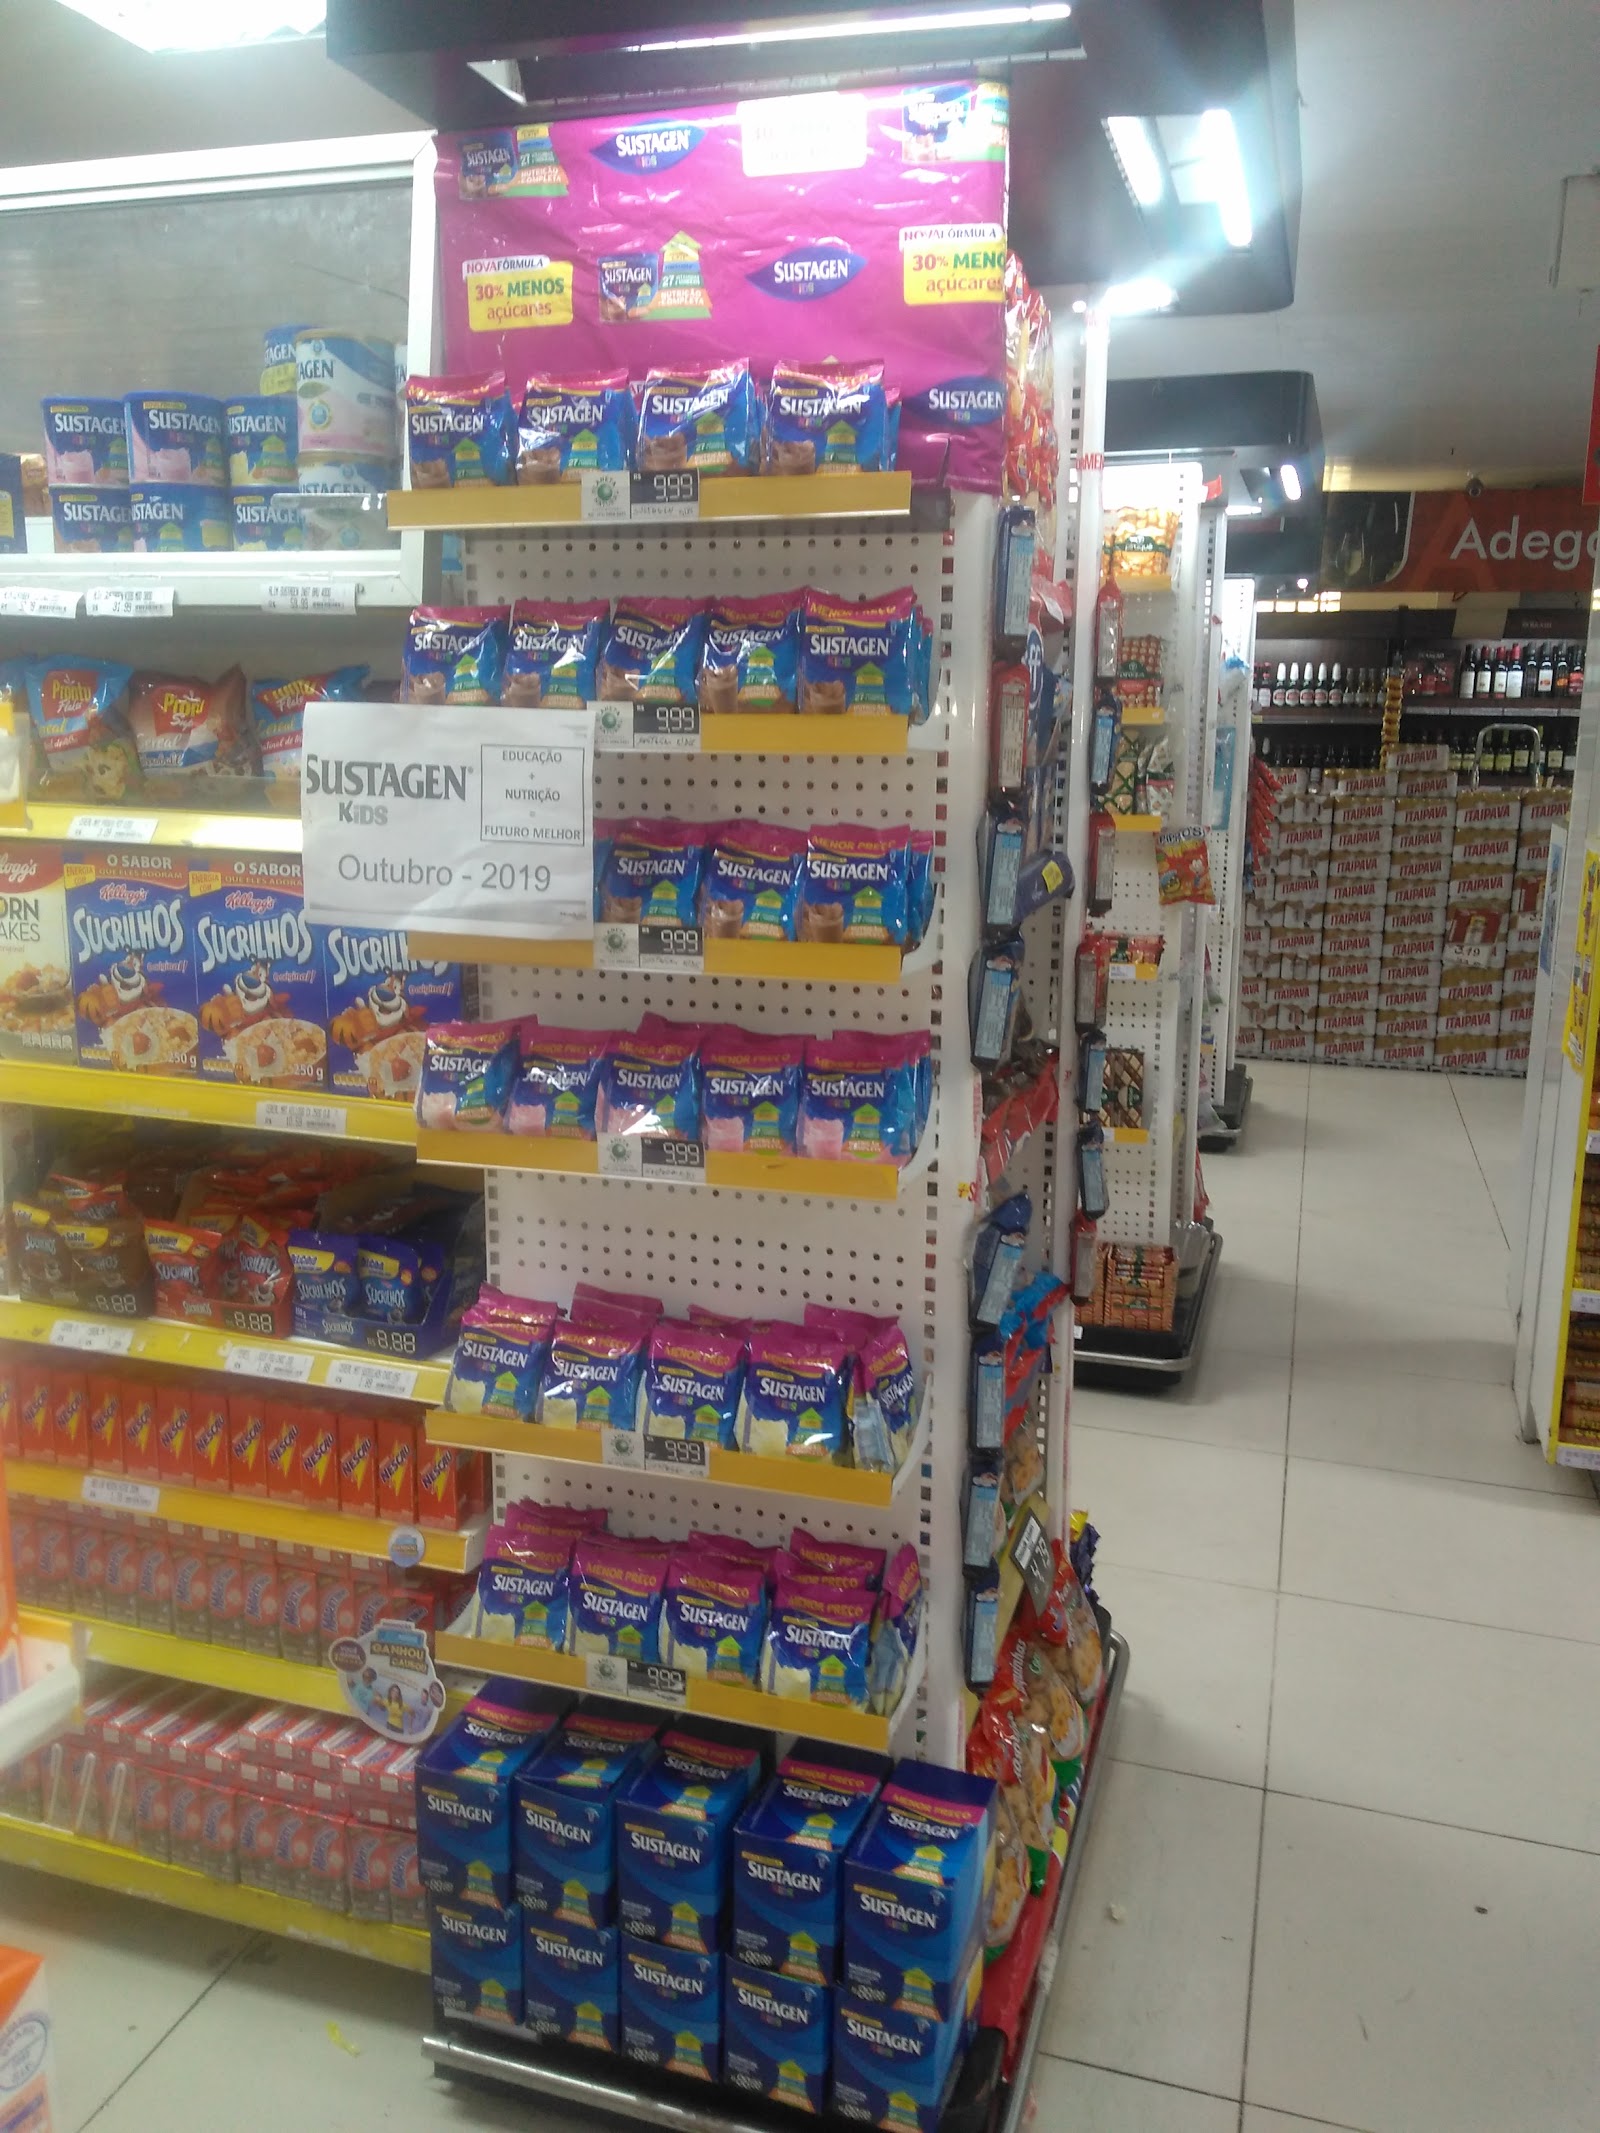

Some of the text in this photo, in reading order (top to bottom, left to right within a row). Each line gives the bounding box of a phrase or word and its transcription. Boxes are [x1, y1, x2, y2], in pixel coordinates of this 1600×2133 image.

[616, 129, 691, 157] SUSTAGEN
[774, 259, 850, 283] SUSTAGEN
[912, 254, 949, 271] 30%
[475, 277, 565, 301] 30% MENOS
[604, 267, 651, 285] SUSTAGEN
[929, 388, 1005, 410] SUSTAGEN
[411, 414, 485, 435] SUSTAGEN
[810, 635, 890, 656] SUSTAGEN
[502, 750, 562, 764] EDUCAÇÃO
[505, 788, 560, 802] NUTRIÇÃO
[484, 825, 581, 840] FUTURO MELHOR
[107, 854, 172, 870] O SABOR
[141, 870, 183, 880] ADORAM
[234, 861, 302, 877] O SABOR
[338, 854, 453, 886] Outubro
[481, 862, 551, 892] 2019
[617, 858, 687, 875] SUSTAGEN
[717, 859, 792, 884] SUSTAGEN
[810, 861, 889, 881] SUSTAGEN
[100, 883, 148, 906] Kellogg's
[225, 890, 276, 914] Kellogg's
[73, 899, 184, 963] SUCRILHOS
[198, 907, 313, 974] SUCRILHOS
[168, 1052, 188, 1065] 250
[812, 1079, 885, 1098] SUSTAGEN
[462, 1340, 529, 1368] SUSTAGEN
[661, 1374, 725, 1402] SUSTAGEN
[759, 1377, 827, 1403] SUSTAGEN
[303, 1433, 334, 1474] NESCAU
[380, 1445, 411, 1484] NESCAU
[421, 1451, 453, 1491] NESCAU
[492, 1574, 554, 1597] SUSTAGEN
[583, 1591, 649, 1622] SUSTAGEN
[680, 1604, 750, 1632] SUSTAGEN
[427, 1795, 493, 1825] SUSTAGEN
[526, 1809, 592, 1845] SUSTAGEN
[631, 1831, 702, 1865] SUSTAGEN
[748, 1860, 822, 1893] SUSTAGEN
[860, 1893, 938, 1929] SUSTAGEN
[441, 1915, 508, 1943] SUSTAGEN
[536, 1936, 604, 1967] SUSTAGEN
[634, 1963, 704, 1995] SUSTAGEN
[738, 1987, 810, 2025] SUSTAGEN
[847, 2018, 922, 2056] SUSTAGEN
